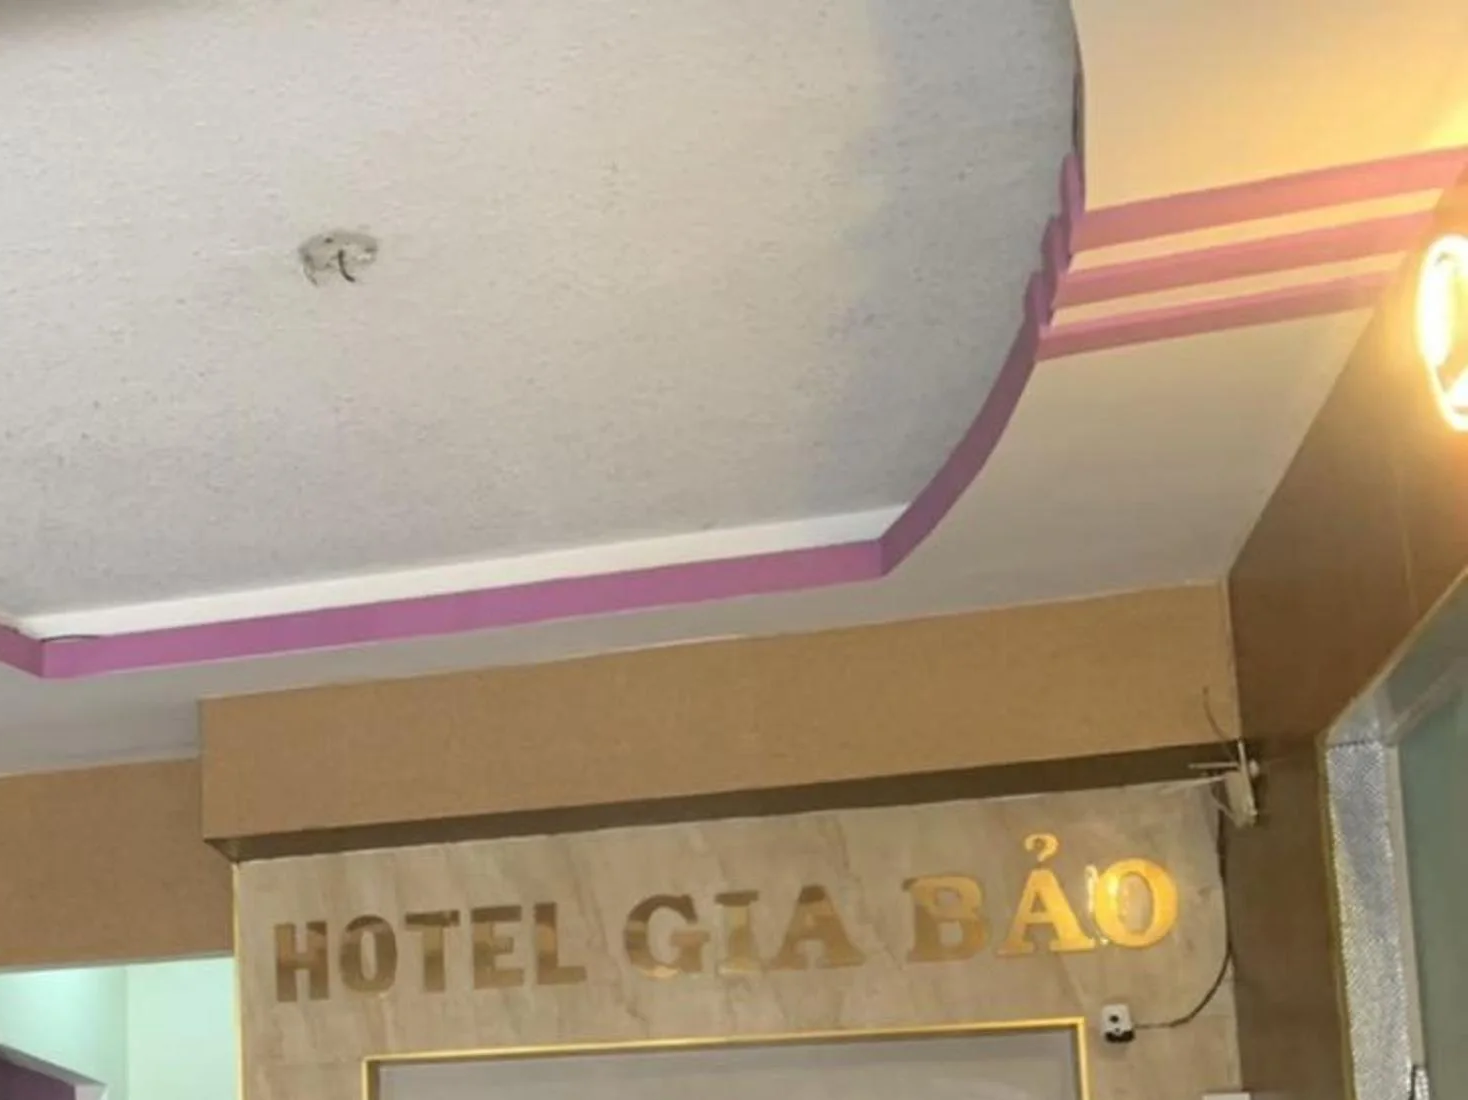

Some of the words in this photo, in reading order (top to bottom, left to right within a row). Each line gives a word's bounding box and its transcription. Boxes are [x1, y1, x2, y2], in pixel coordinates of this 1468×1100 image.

[274, 900, 588, 1001] HOTEL
[623, 883, 864, 980] GIA
[903, 832, 1179, 964] BẢO
